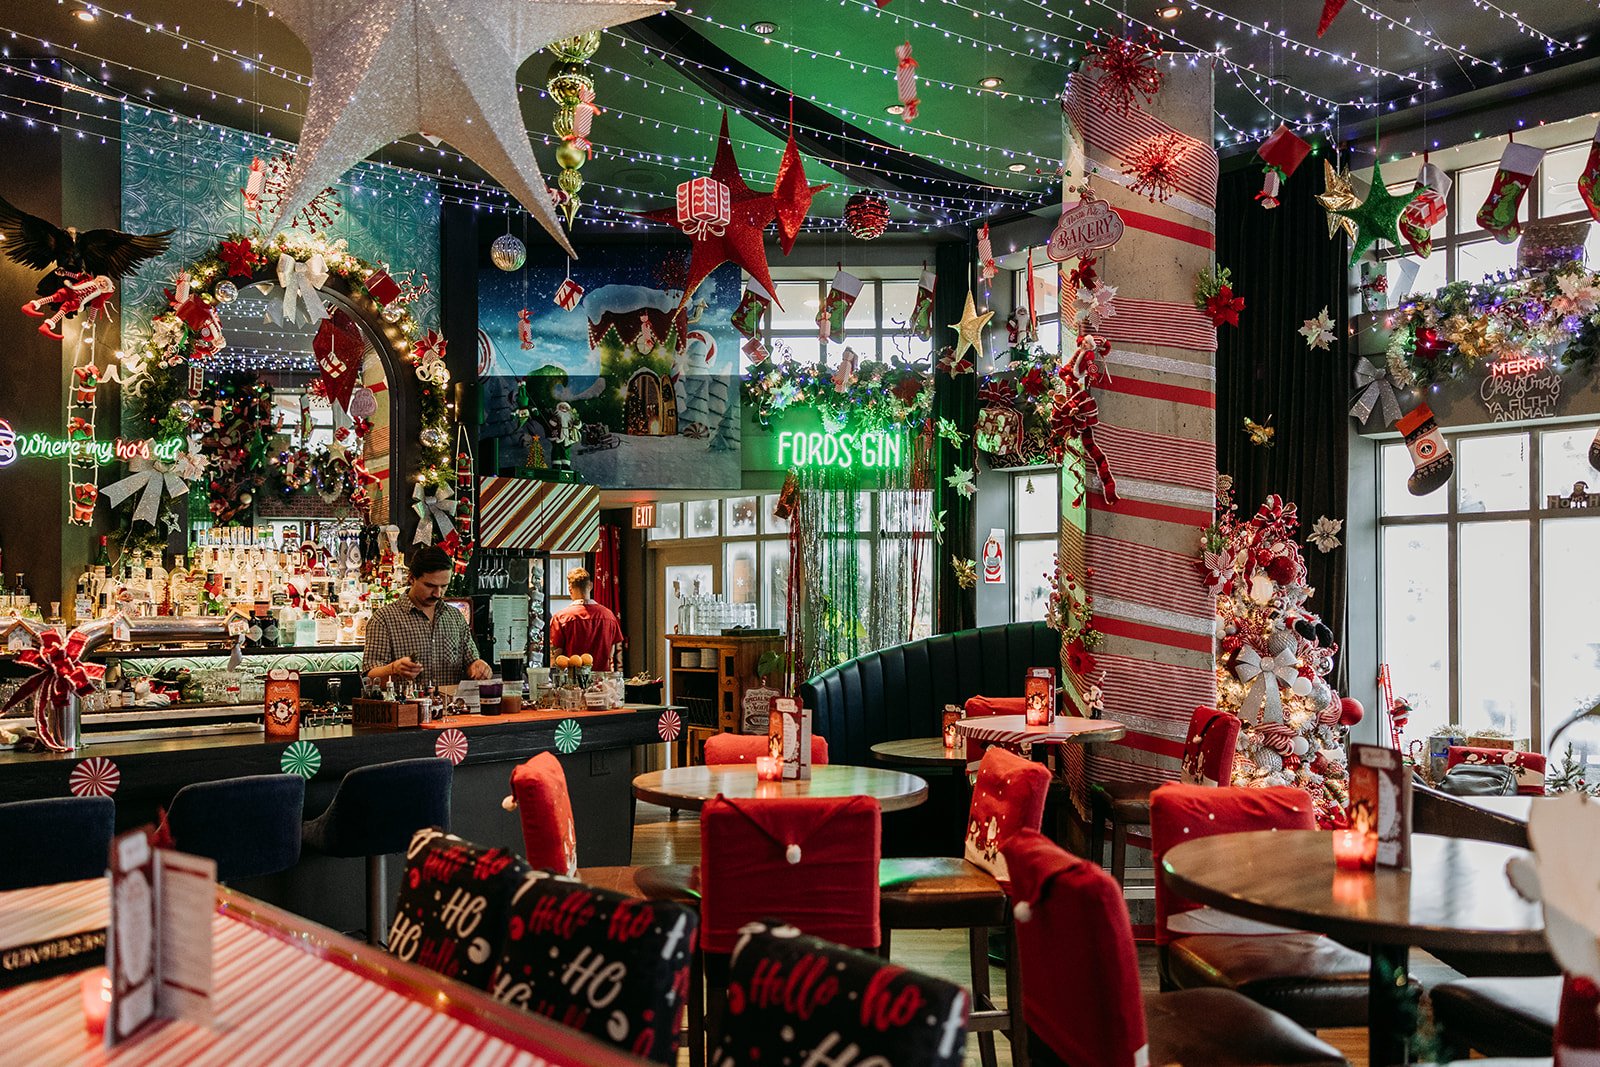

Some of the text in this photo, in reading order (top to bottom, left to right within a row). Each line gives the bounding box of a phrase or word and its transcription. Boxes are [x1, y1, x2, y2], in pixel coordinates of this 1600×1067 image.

[1057, 214, 1113, 250] BAKERY
[1492, 355, 1546, 375] MERRY
[1481, 373, 1562, 401] Christmas
[1485, 394, 1559, 413] YA FILTHY
[1494, 406, 1554, 423] ANIMAL
[16, 433, 182, 462] Where my ho's at?
[778, 432, 900, 468] FORDS GIN
[636, 505, 653, 527] EXIT
[441, 887, 487, 938] HO
[388, 911, 422, 962] HO
[561, 946, 627, 1009] HO
[751, 953, 840, 1021] Hello
[860, 964, 925, 1032] ho
